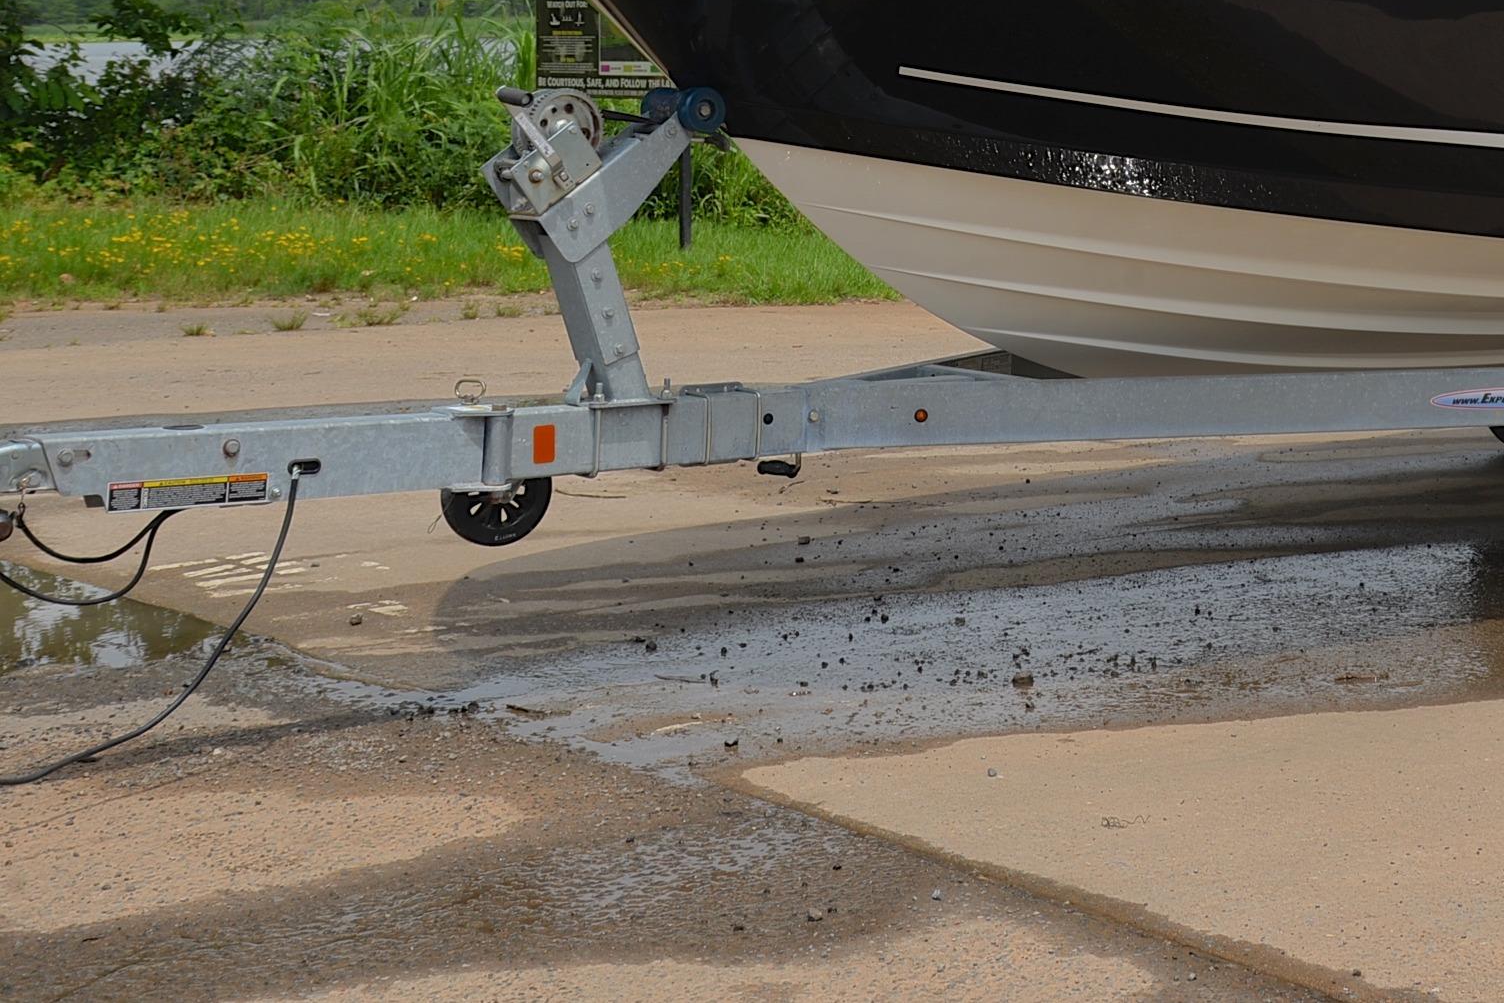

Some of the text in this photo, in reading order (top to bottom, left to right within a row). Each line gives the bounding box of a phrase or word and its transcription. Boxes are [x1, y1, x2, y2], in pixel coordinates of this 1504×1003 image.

[547, 77, 586, 89] COURTEOUS,
[587, 77, 604, 89] SAFE,
[605, 78, 620, 88] AND
[620, 78, 647, 88] FOLLOW
[648, 79, 660, 88] THE
